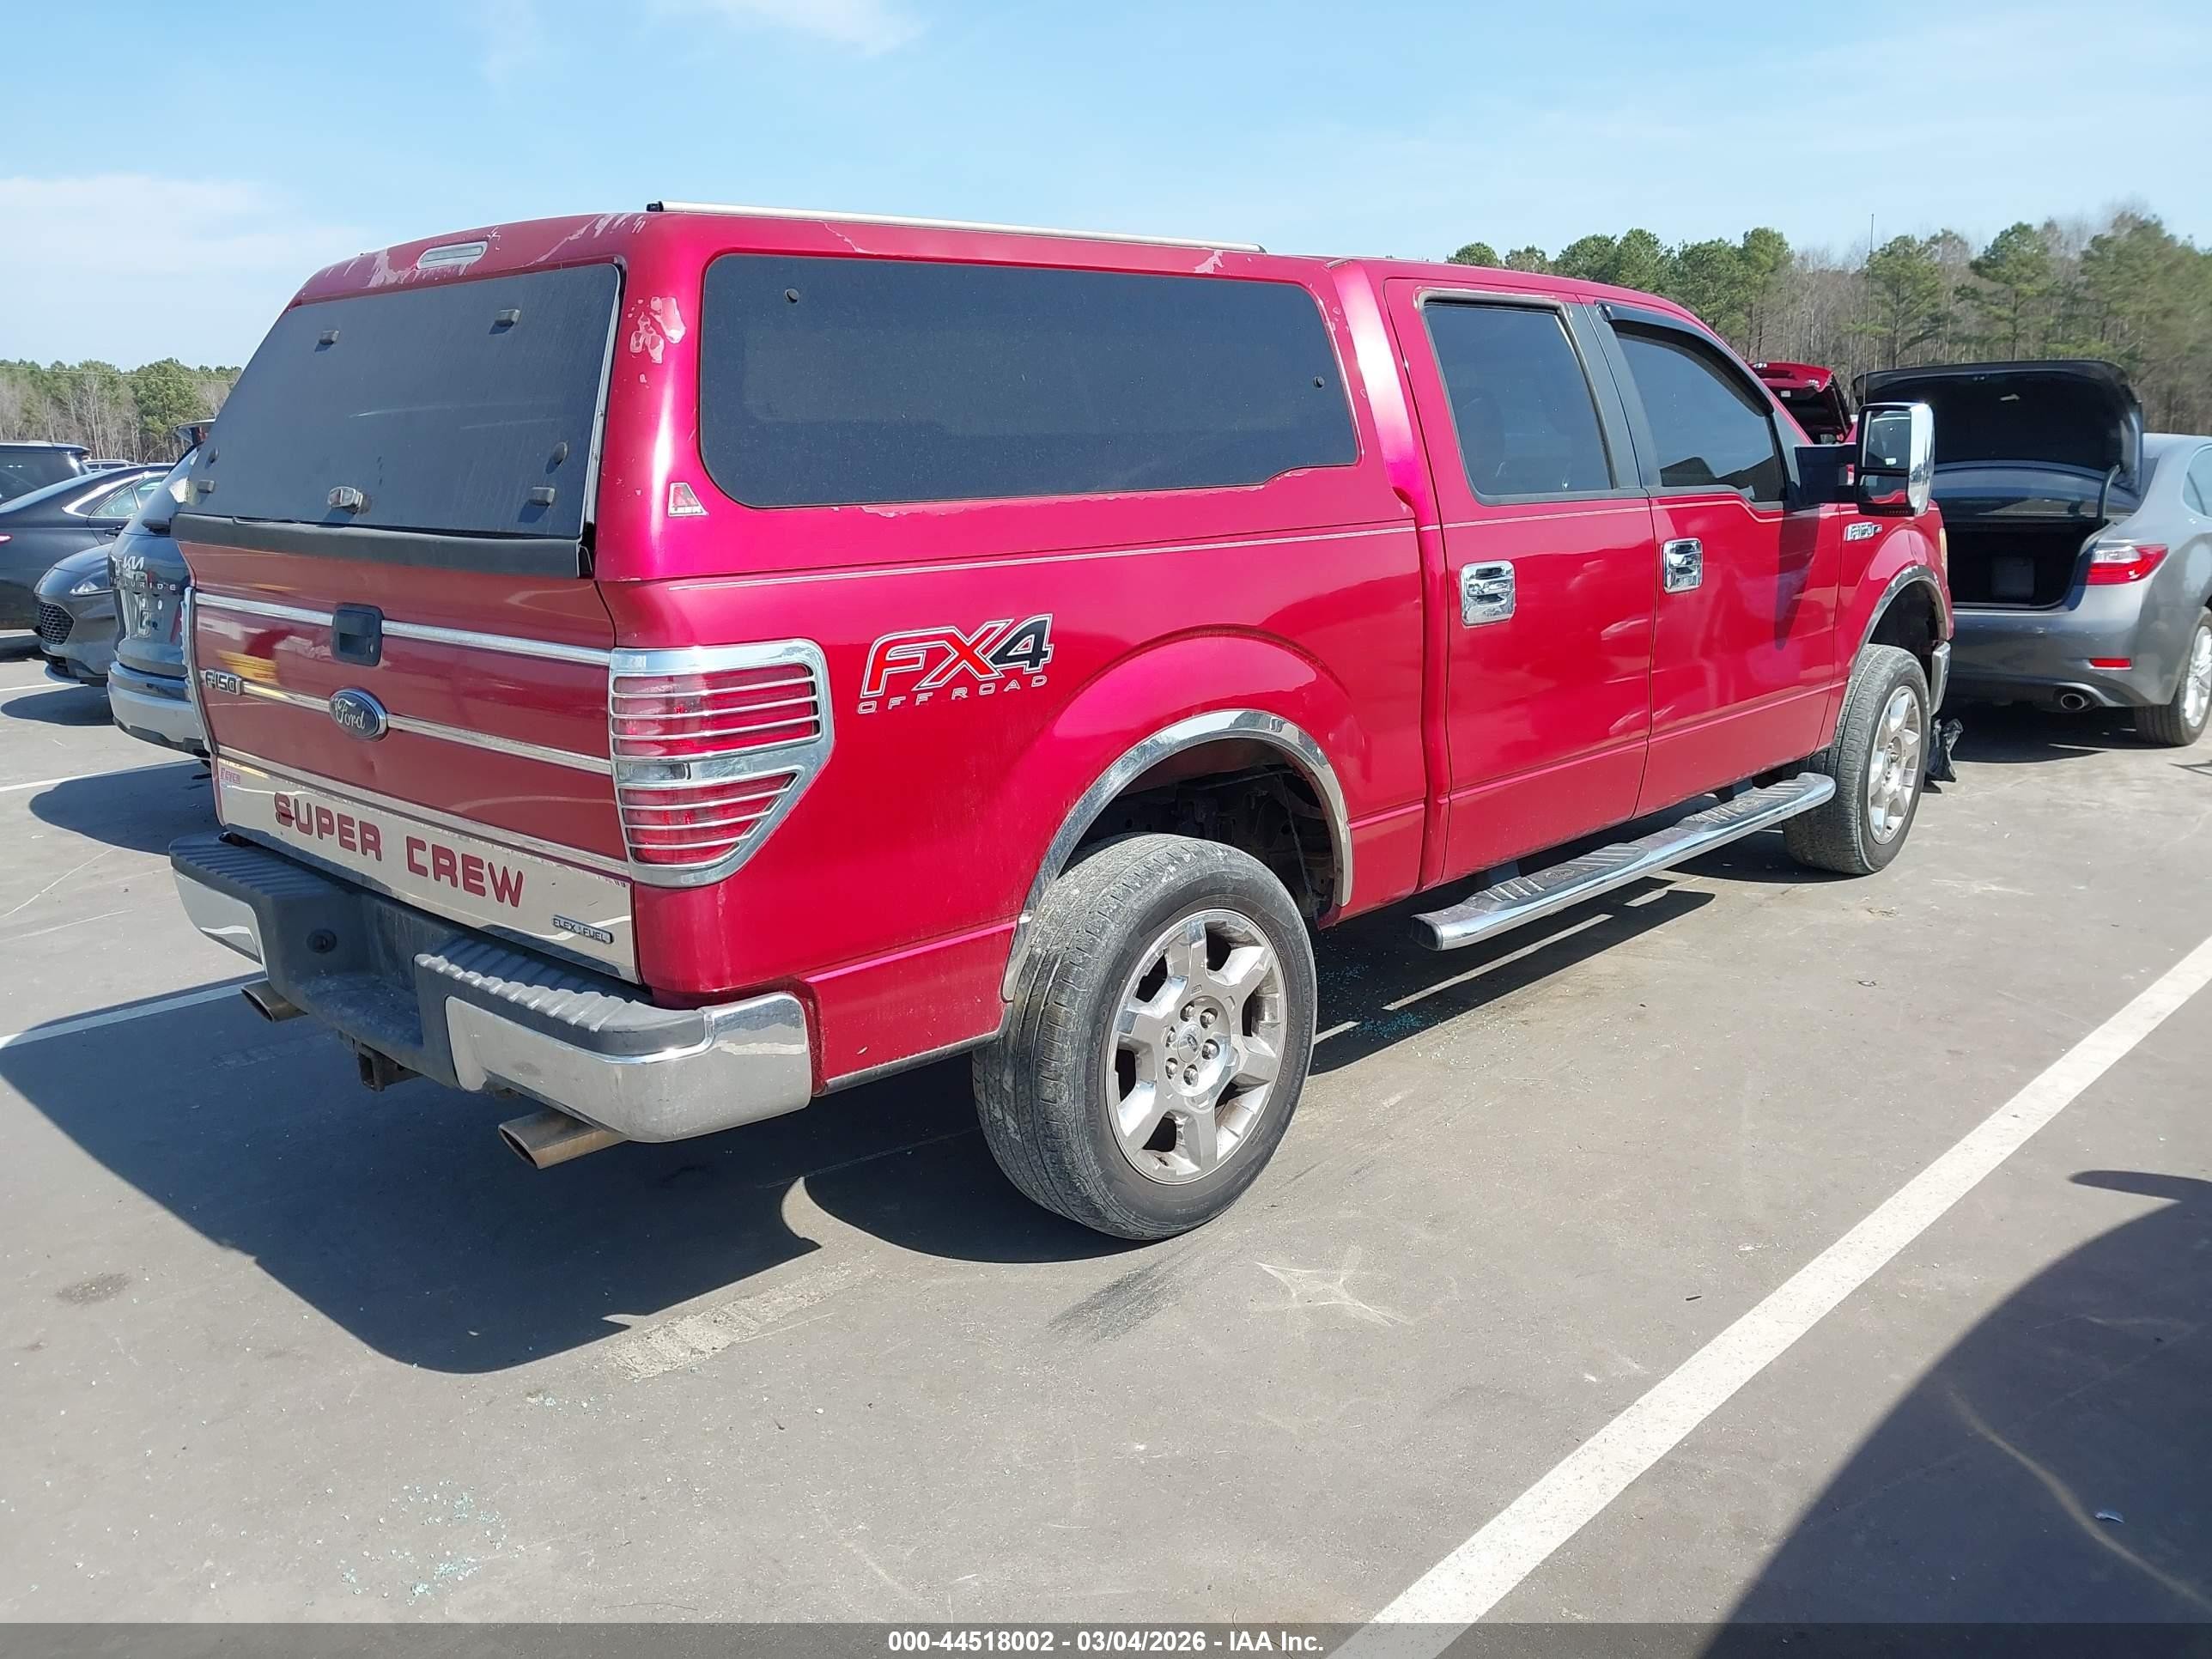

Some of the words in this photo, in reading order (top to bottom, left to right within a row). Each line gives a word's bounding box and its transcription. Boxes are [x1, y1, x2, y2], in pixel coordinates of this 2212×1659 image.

[860, 613, 1054, 699] FX4
[334, 697, 366, 730] Ford
[857, 690, 934, 714] OFF
[951, 674, 1048, 702] ROAD
[274, 792, 383, 862] SUPER
[405, 835, 525, 908] CREW
